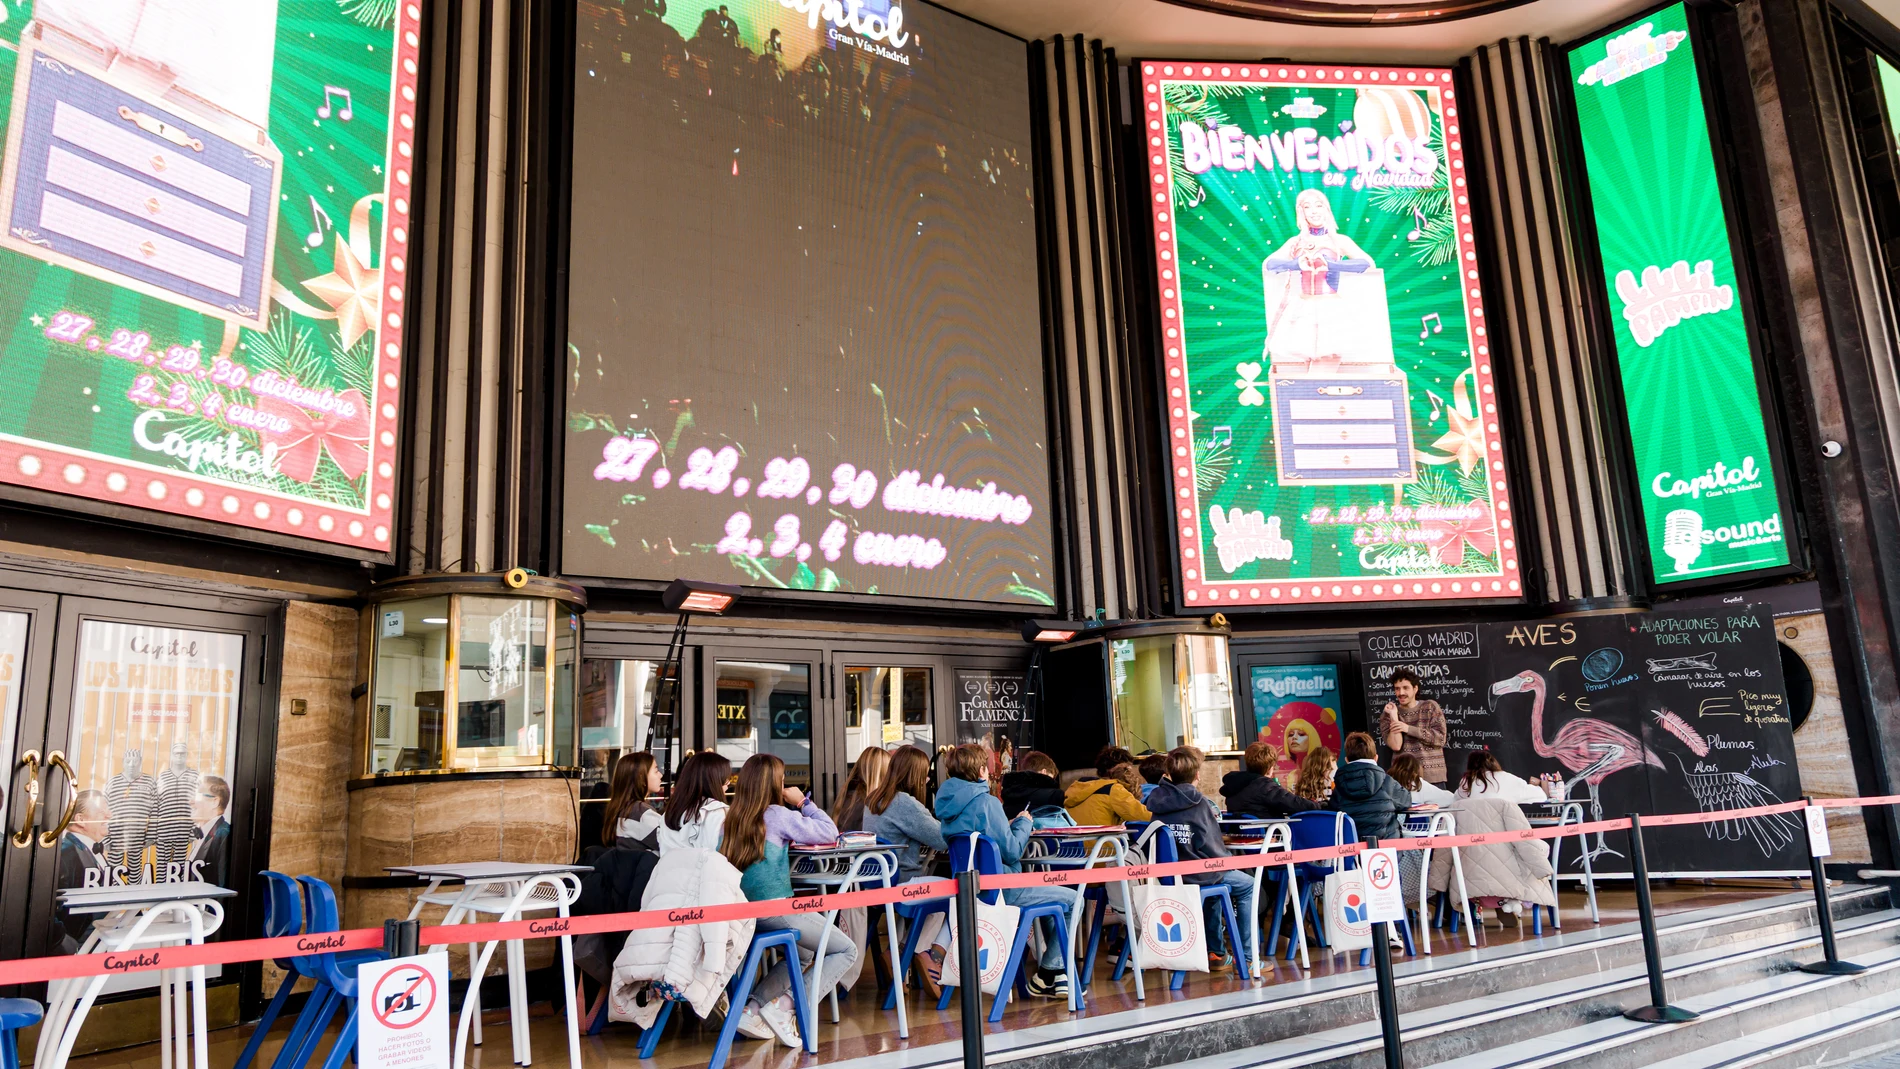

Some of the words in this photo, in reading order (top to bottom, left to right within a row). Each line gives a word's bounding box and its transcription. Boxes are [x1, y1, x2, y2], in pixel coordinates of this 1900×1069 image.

[829, 28, 853, 46] Gran
[1323, 172, 1346, 186] en
[1352, 169, 1435, 191] Navidad
[211, 357, 248, 389] 30
[251, 371, 356, 418] diciembre
[202, 393, 222, 419] 4
[226, 402, 291, 433] enero
[133, 411, 282, 478] Capitol
[1652, 456, 1760, 499] Capitol
[829, 463, 878, 509] 30
[883, 470, 1032, 525] diciembre
[1416, 505, 1482, 521] diciembre
[1404, 528, 1443, 542] enero
[820, 519, 848, 562] 4
[853, 531, 947, 570] enero
[1359, 545, 1443, 575] Capitol
[1639, 617, 1719, 634] ADAPTACIONES
[1727, 615, 1761, 629] PARA
[1368, 633, 1423, 651] COLEGIO
[1428, 631, 1474, 646] MADRID
[1505, 621, 1577, 647] AVES
[1656, 632, 1691, 646] PODER
[1698, 630, 1742, 644] VOLAR
[131, 636, 198, 659] Capitol
[1421, 647, 1446, 656] SANTA
[84, 660, 120, 688] LOS
[1704, 672, 1724, 683] aire
[1744, 668, 1762, 678] los
[1256, 675, 1335, 698] Raffaella
[1738, 689, 1759, 701] Pico
[1761, 694, 1783, 706] muy
[1455, 704, 1463, 715] el
[1743, 701, 1776, 716] ligero
[1743, 714, 1753, 723] de
[1452, 729, 1473, 738] 11000
[1694, 761, 1719, 773] Alas
[1274, 852, 1293, 863] Capitol
[1338, 845, 1356, 856] Capitol
[1127, 866, 1150, 880] Capitol
[1204, 859, 1226, 871] Capitol
[1043, 873, 1067, 884] Capitol
[902, 885, 931, 898] Capitol
[792, 898, 824, 911] Capitol
[668, 909, 704, 925] Capitol
[529, 920, 570, 935] Capitol
[297, 935, 346, 953] Capitol
[104, 953, 160, 971] Capitol
[387, 1032, 423, 1043] PROHIBIDO
[378, 1043, 401, 1053] HACER
[402, 1039, 424, 1048] FOTOS
[378, 1050, 406, 1061] GRABAR
[392, 1055, 424, 1065] MENORES
